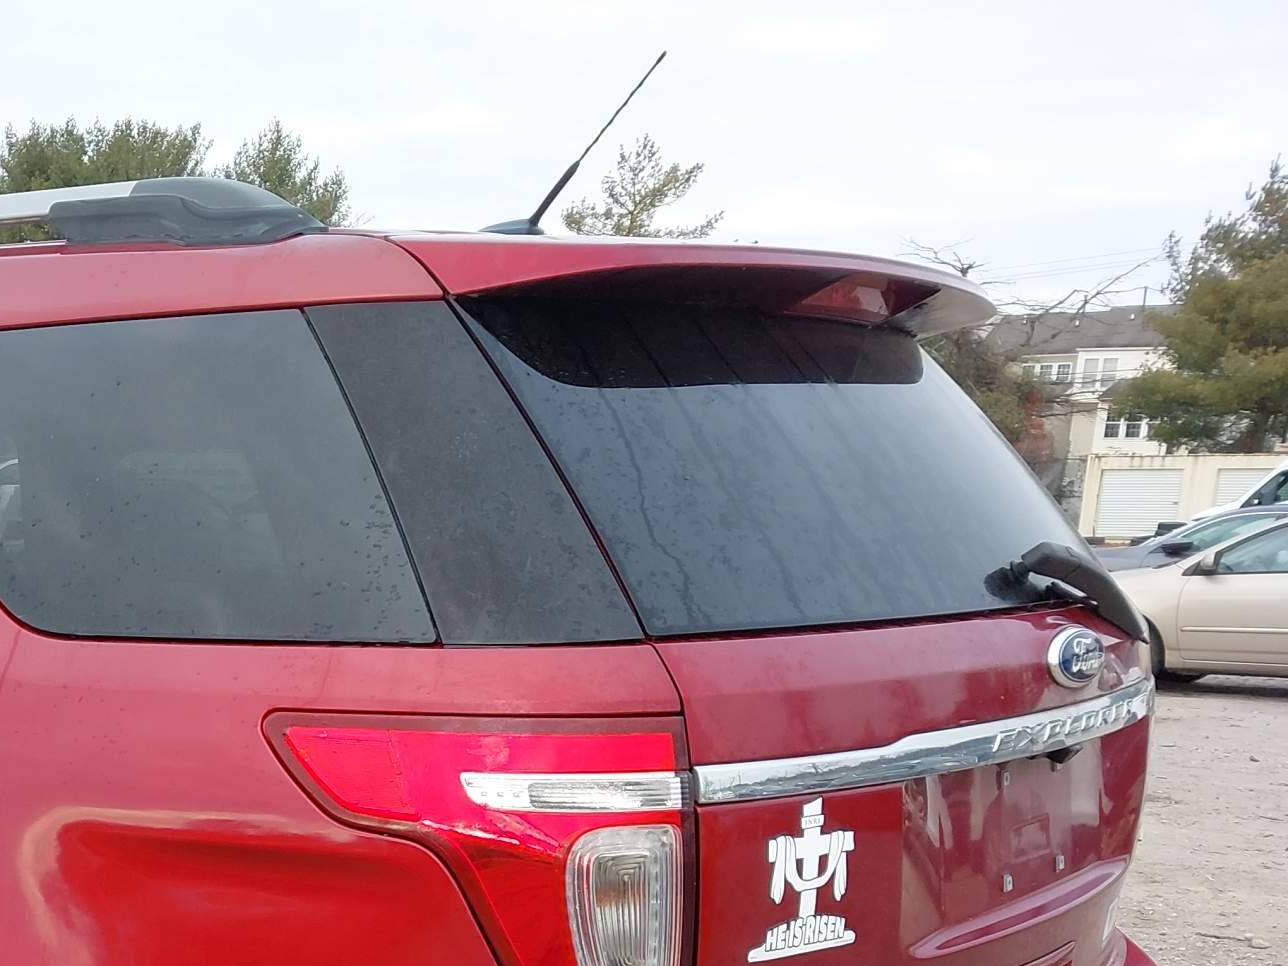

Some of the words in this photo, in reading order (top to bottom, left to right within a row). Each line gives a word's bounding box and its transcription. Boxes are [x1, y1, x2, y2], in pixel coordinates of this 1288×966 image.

[1070, 637, 1104, 674] Ford
[765, 923, 787, 952] HE
[787, 918, 804, 948] IS
[804, 915, 846, 946] RISEN
